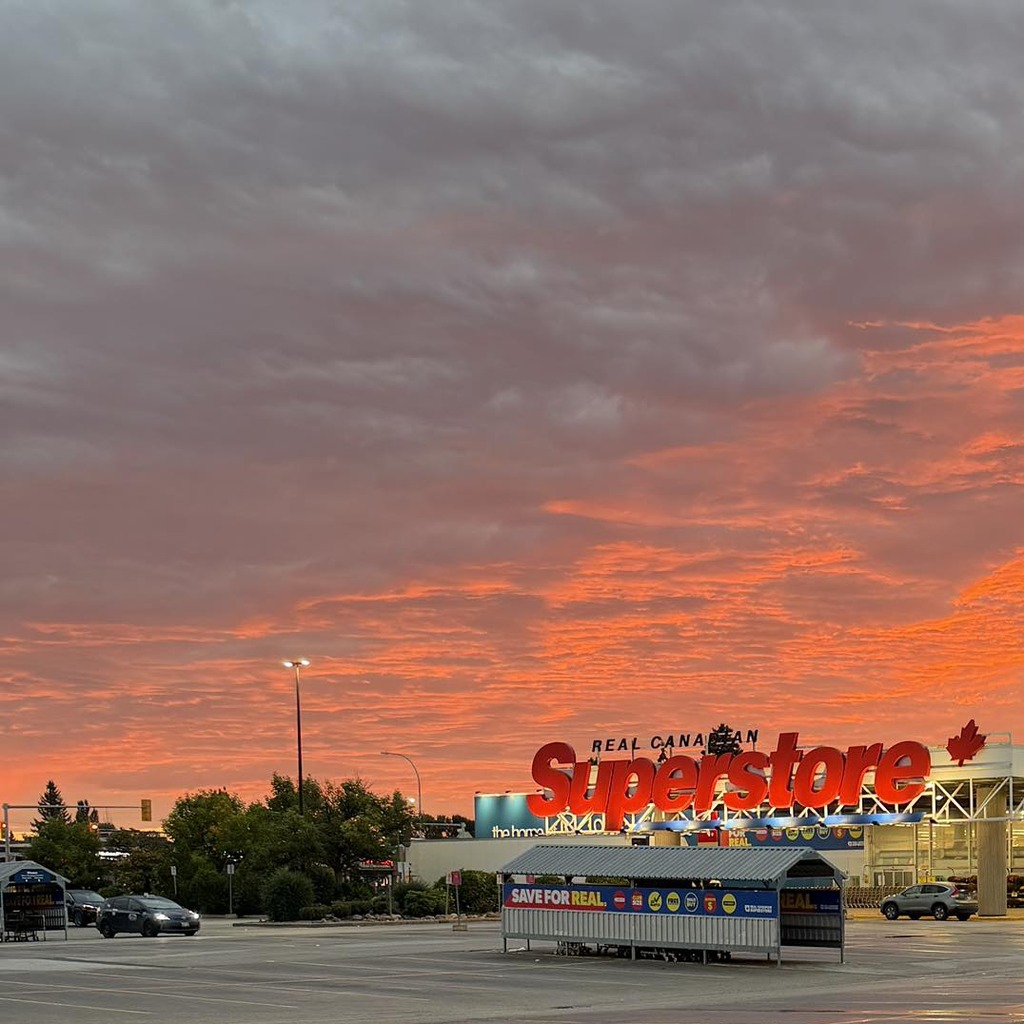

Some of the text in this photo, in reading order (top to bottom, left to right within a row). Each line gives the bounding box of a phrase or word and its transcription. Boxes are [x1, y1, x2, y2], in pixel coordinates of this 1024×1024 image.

[592, 730, 759, 752] REAL CANAAN
[526, 732, 931, 832] Superstore
[492, 825, 544, 838] the home
[511, 888, 543, 904] SAVE
[544, 889, 570, 905] FOR
